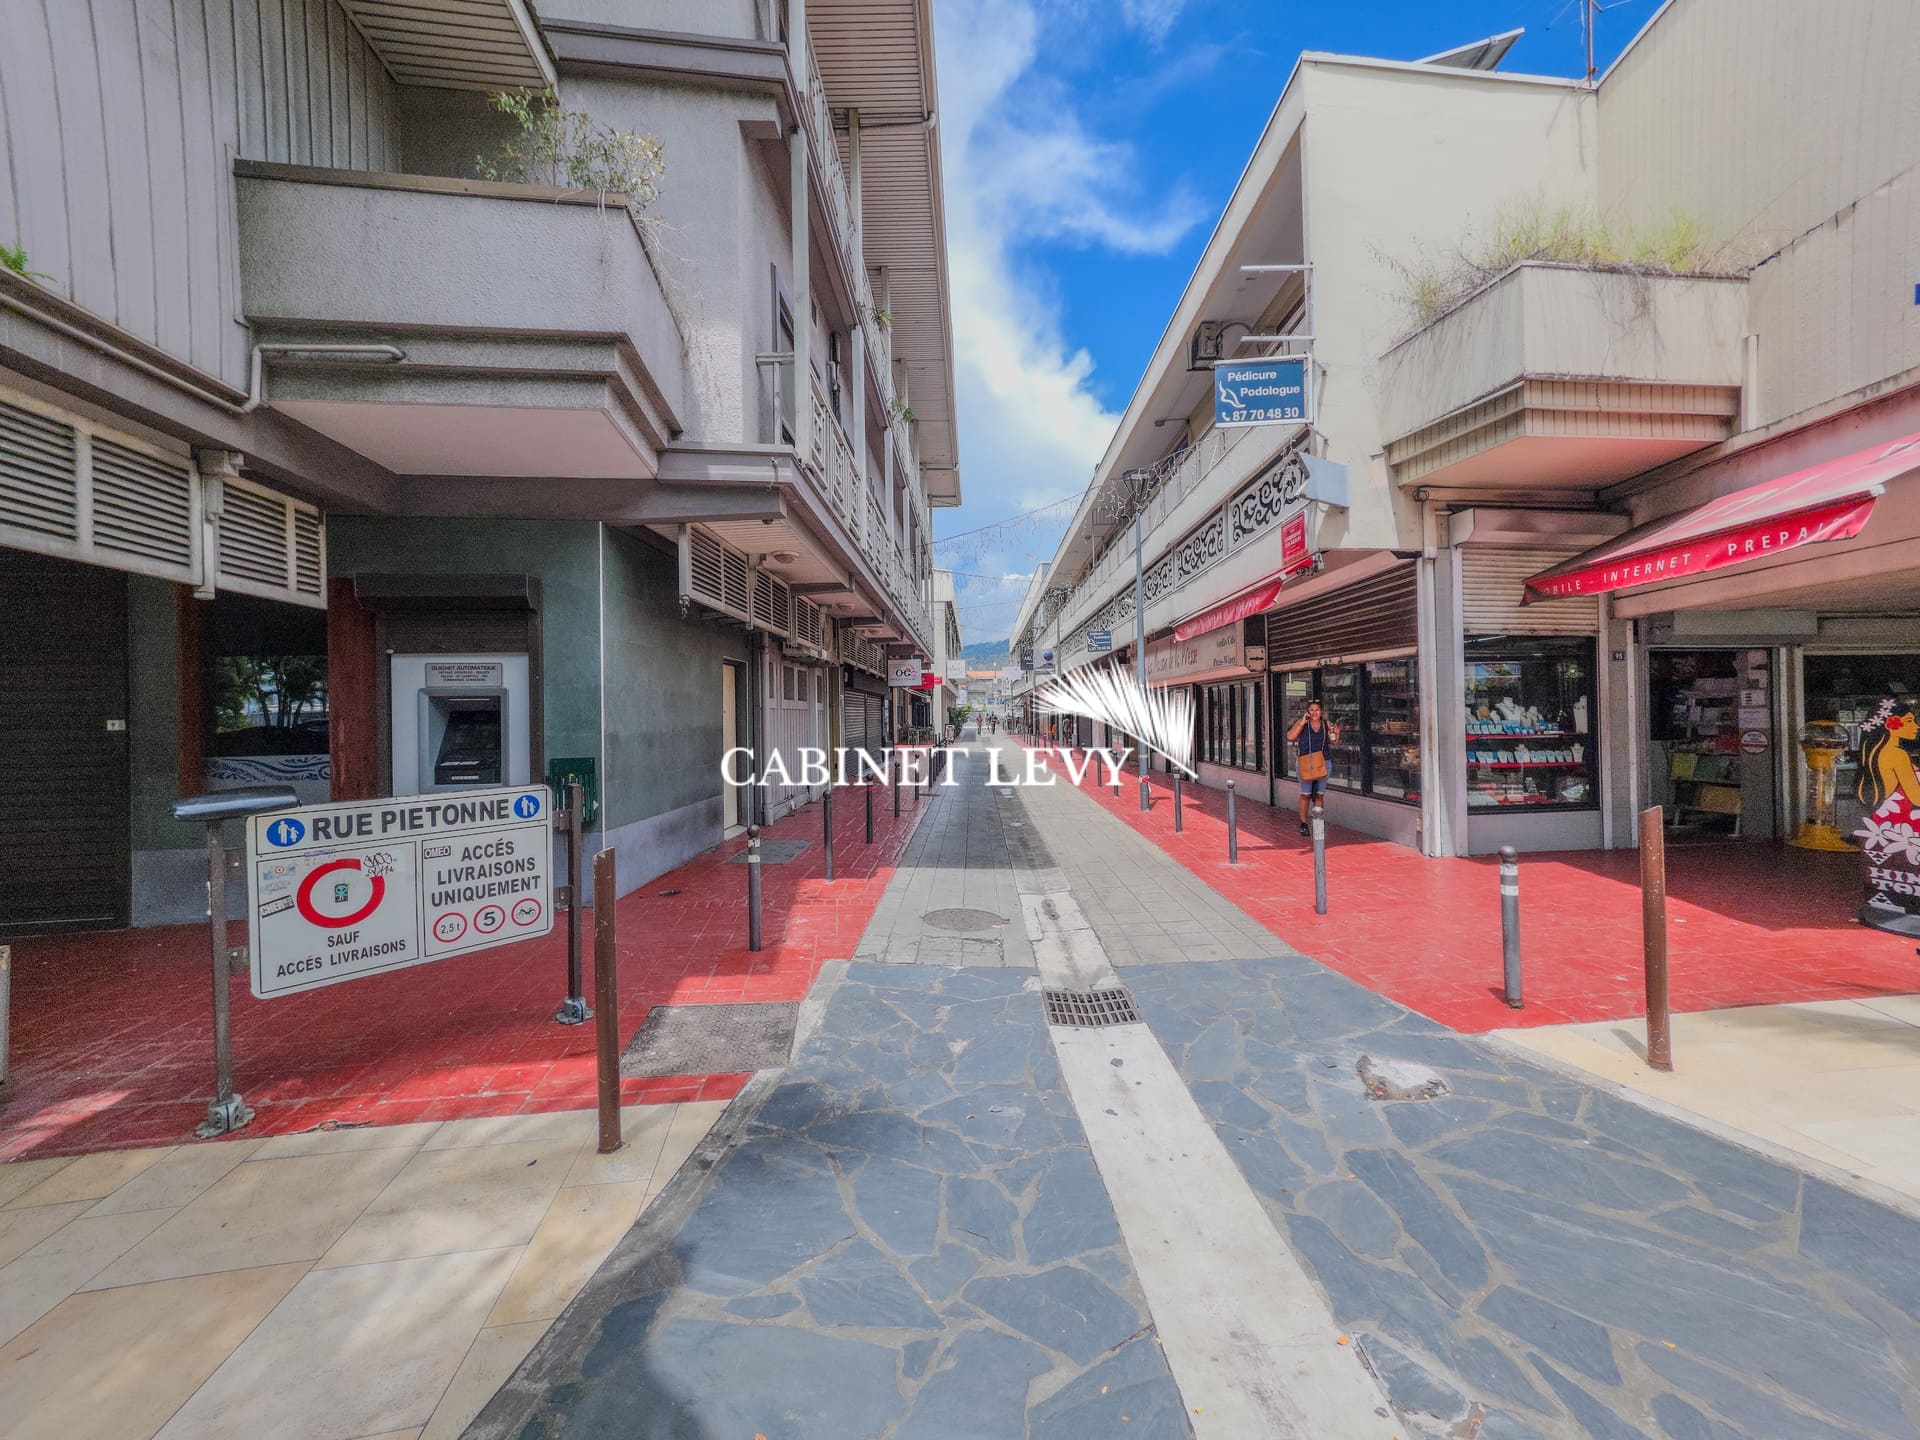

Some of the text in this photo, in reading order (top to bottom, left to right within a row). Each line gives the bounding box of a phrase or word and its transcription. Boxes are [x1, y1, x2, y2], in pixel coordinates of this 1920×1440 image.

[1227, 371, 1278, 381] Pédicure
[1240, 385, 1301, 397] Podologue
[1232, 407, 1299, 421] 87 70 48 30
[1603, 553, 1692, 583] INTERNET
[312, 799, 510, 842] RUE PIETONNE
[424, 846, 451, 859] OMEO
[461, 838, 515, 862] ACCÉS
[437, 856, 536, 885] LIVRAISONS
[431, 875, 541, 907] UNIQUEMENT
[483, 911, 496, 927] 5
[440, 923, 455, 934] 2,5
[327, 931, 361, 948] SAUF
[277, 939, 406, 978] ACCÉS LIVRAISONS
